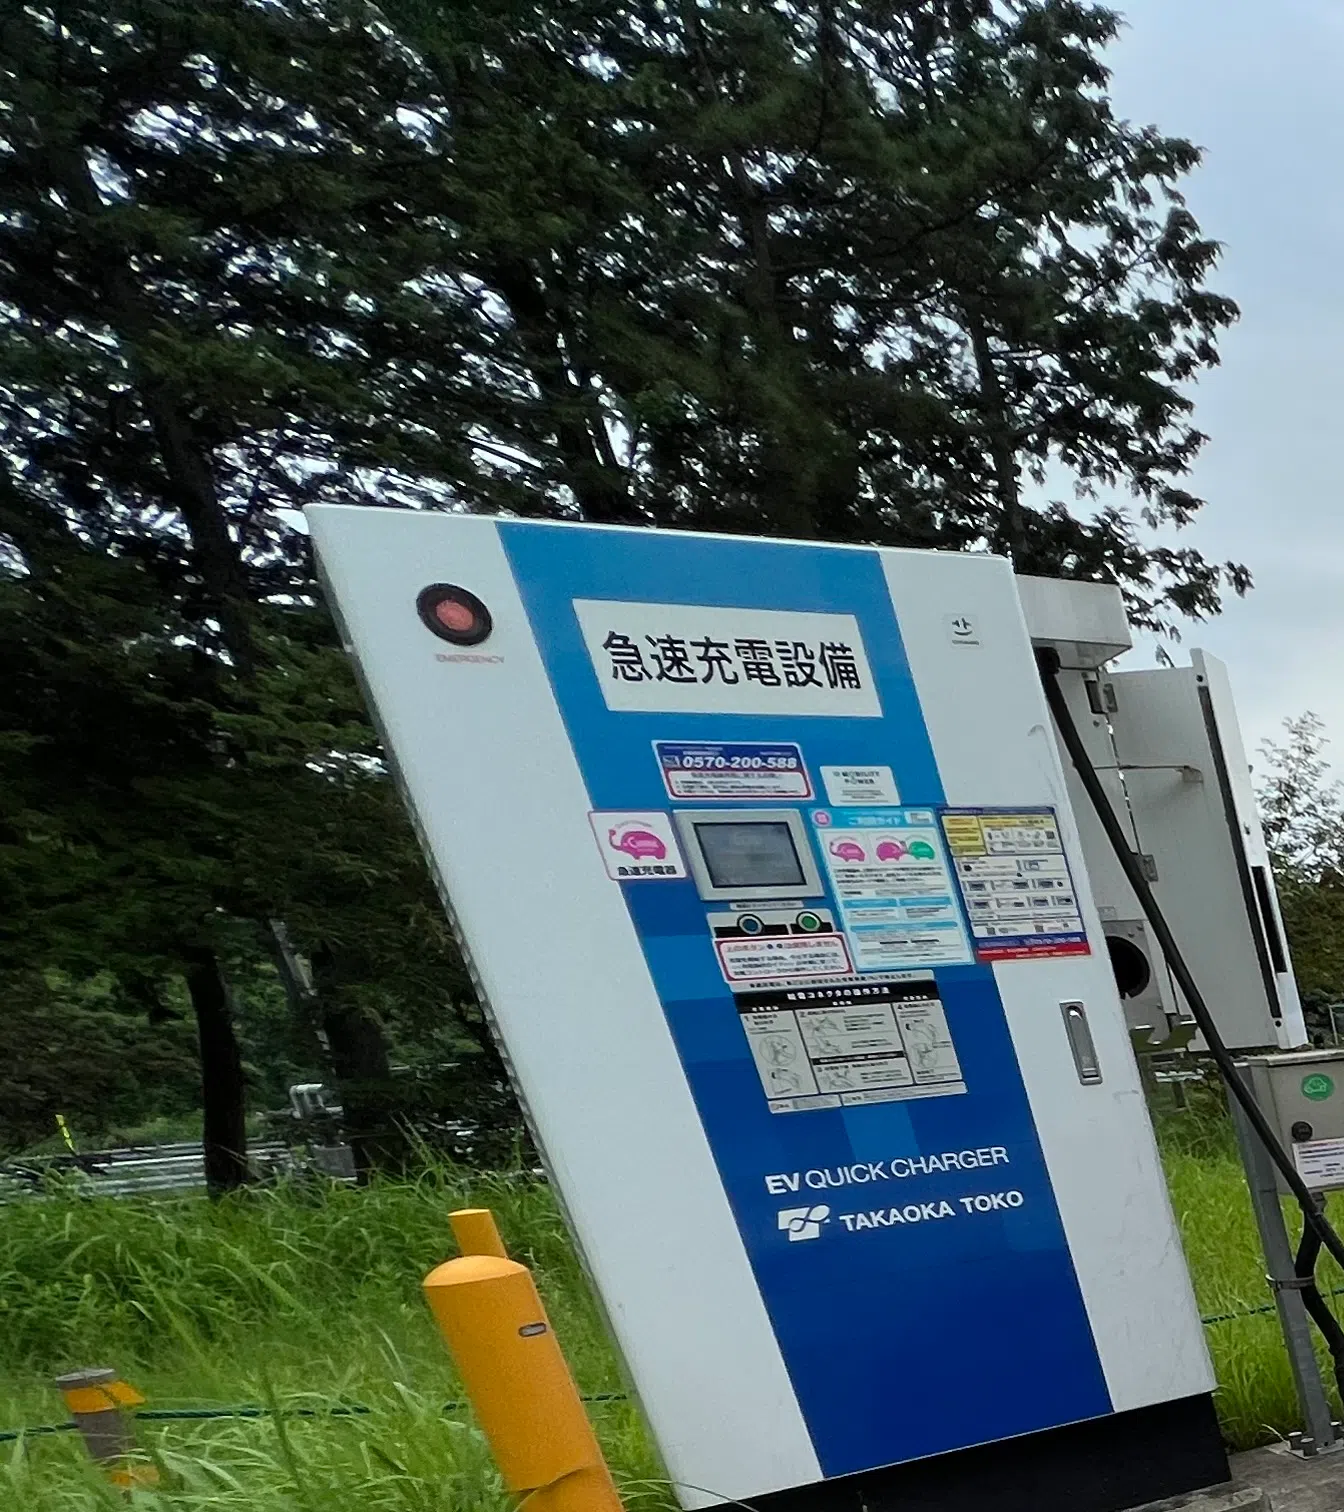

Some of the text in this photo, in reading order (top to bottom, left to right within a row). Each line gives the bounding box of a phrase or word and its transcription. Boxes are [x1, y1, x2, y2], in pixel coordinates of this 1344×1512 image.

[436, 654, 505, 664] EMERGENCY
[602, 631, 861, 689] 急速充電設備
[683, 756, 797, 769] 0570-200-588
[764, 1146, 1010, 1195] EV QUICK CHARGER
[839, 1190, 1025, 1232] TAKAOKA TOKO
